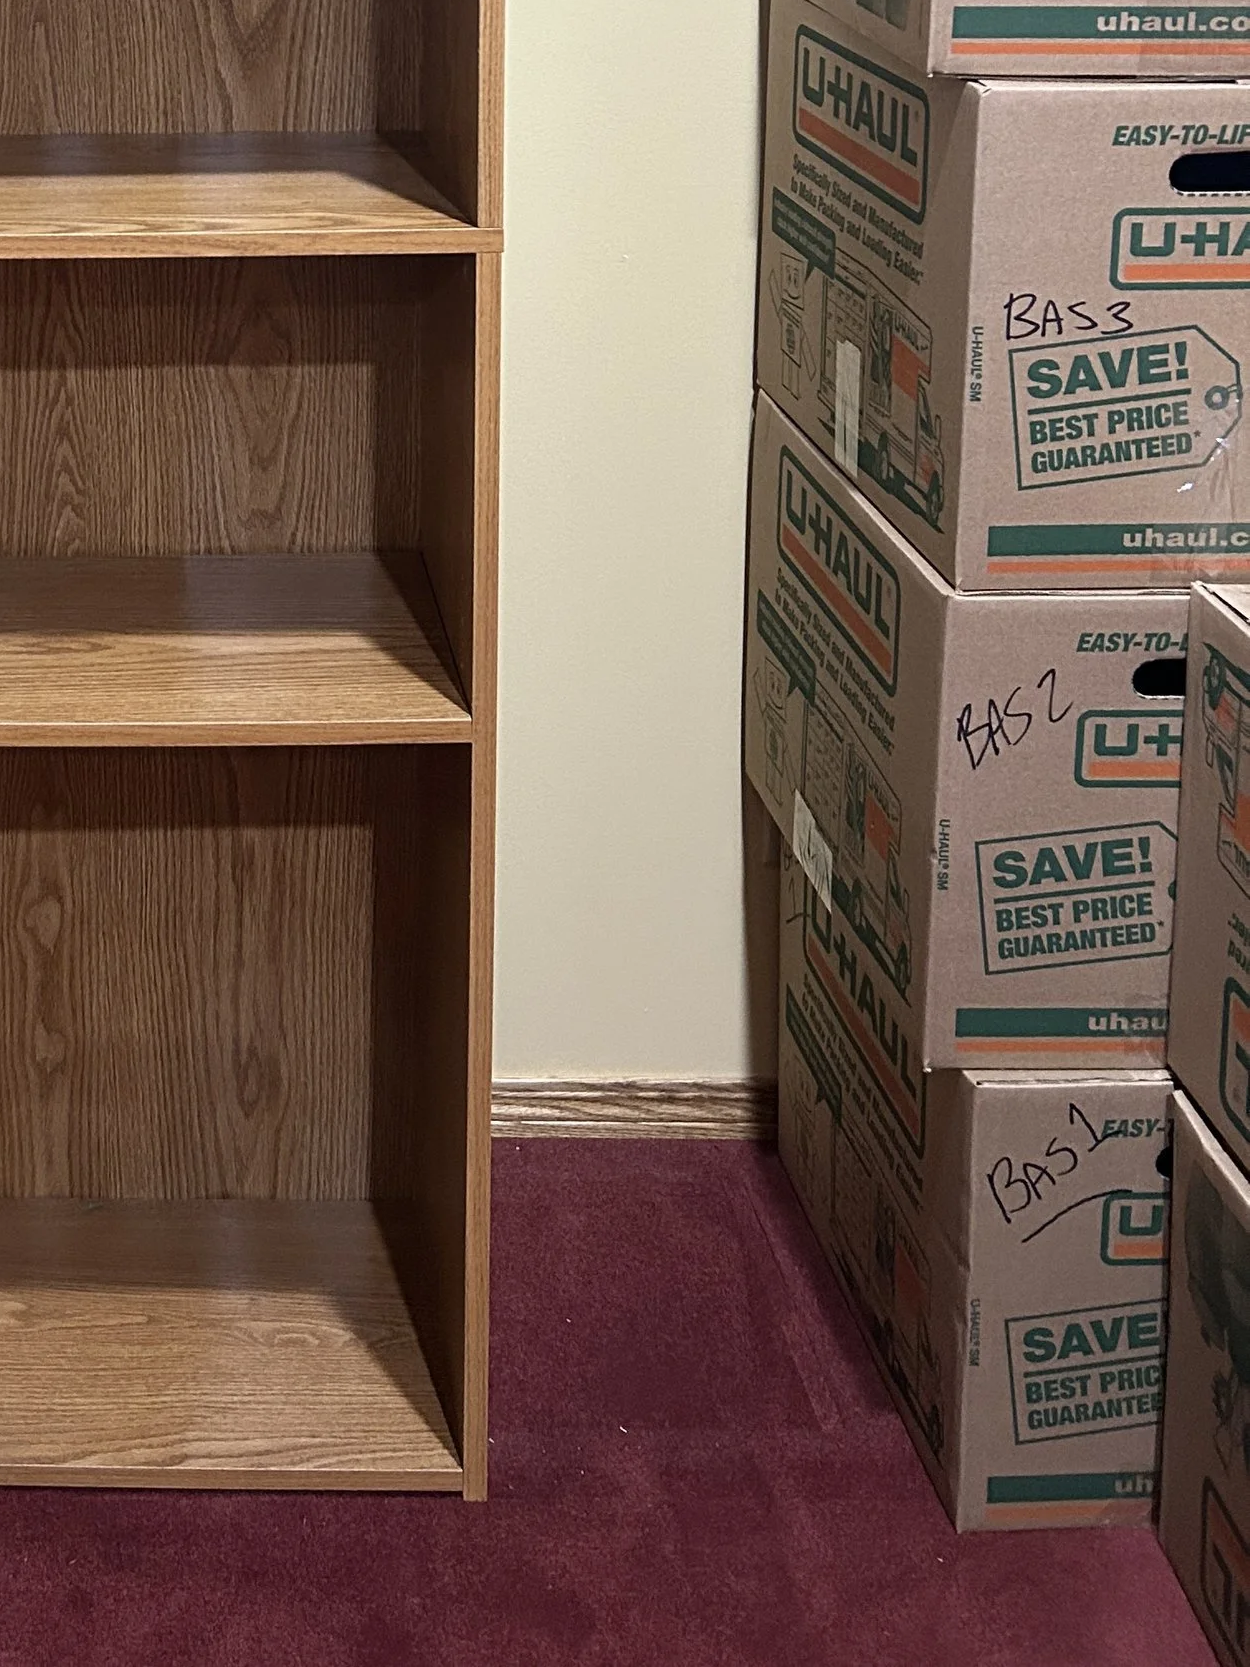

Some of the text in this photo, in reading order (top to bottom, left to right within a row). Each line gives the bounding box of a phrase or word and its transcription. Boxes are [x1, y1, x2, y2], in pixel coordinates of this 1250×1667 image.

[803, 47, 918, 167] U-HAUL
[847, 221, 861, 241] and
[852, 199, 867, 220] and
[970, 382, 982, 402] SM
[1027, 341, 1189, 399] SAVE!
[1029, 400, 1190, 445] BEST PRICE
[957, 668, 1074, 770] BAS 2
[937, 872, 948, 891] SM
[993, 836, 1152, 889] SAVE!
[996, 892, 1153, 932] BEST PRICE
[987, 1137, 1078, 1224] BAS
[1023, 1312, 1160, 1363] SAVE
[1025, 1374, 1091, 1404] BEST
